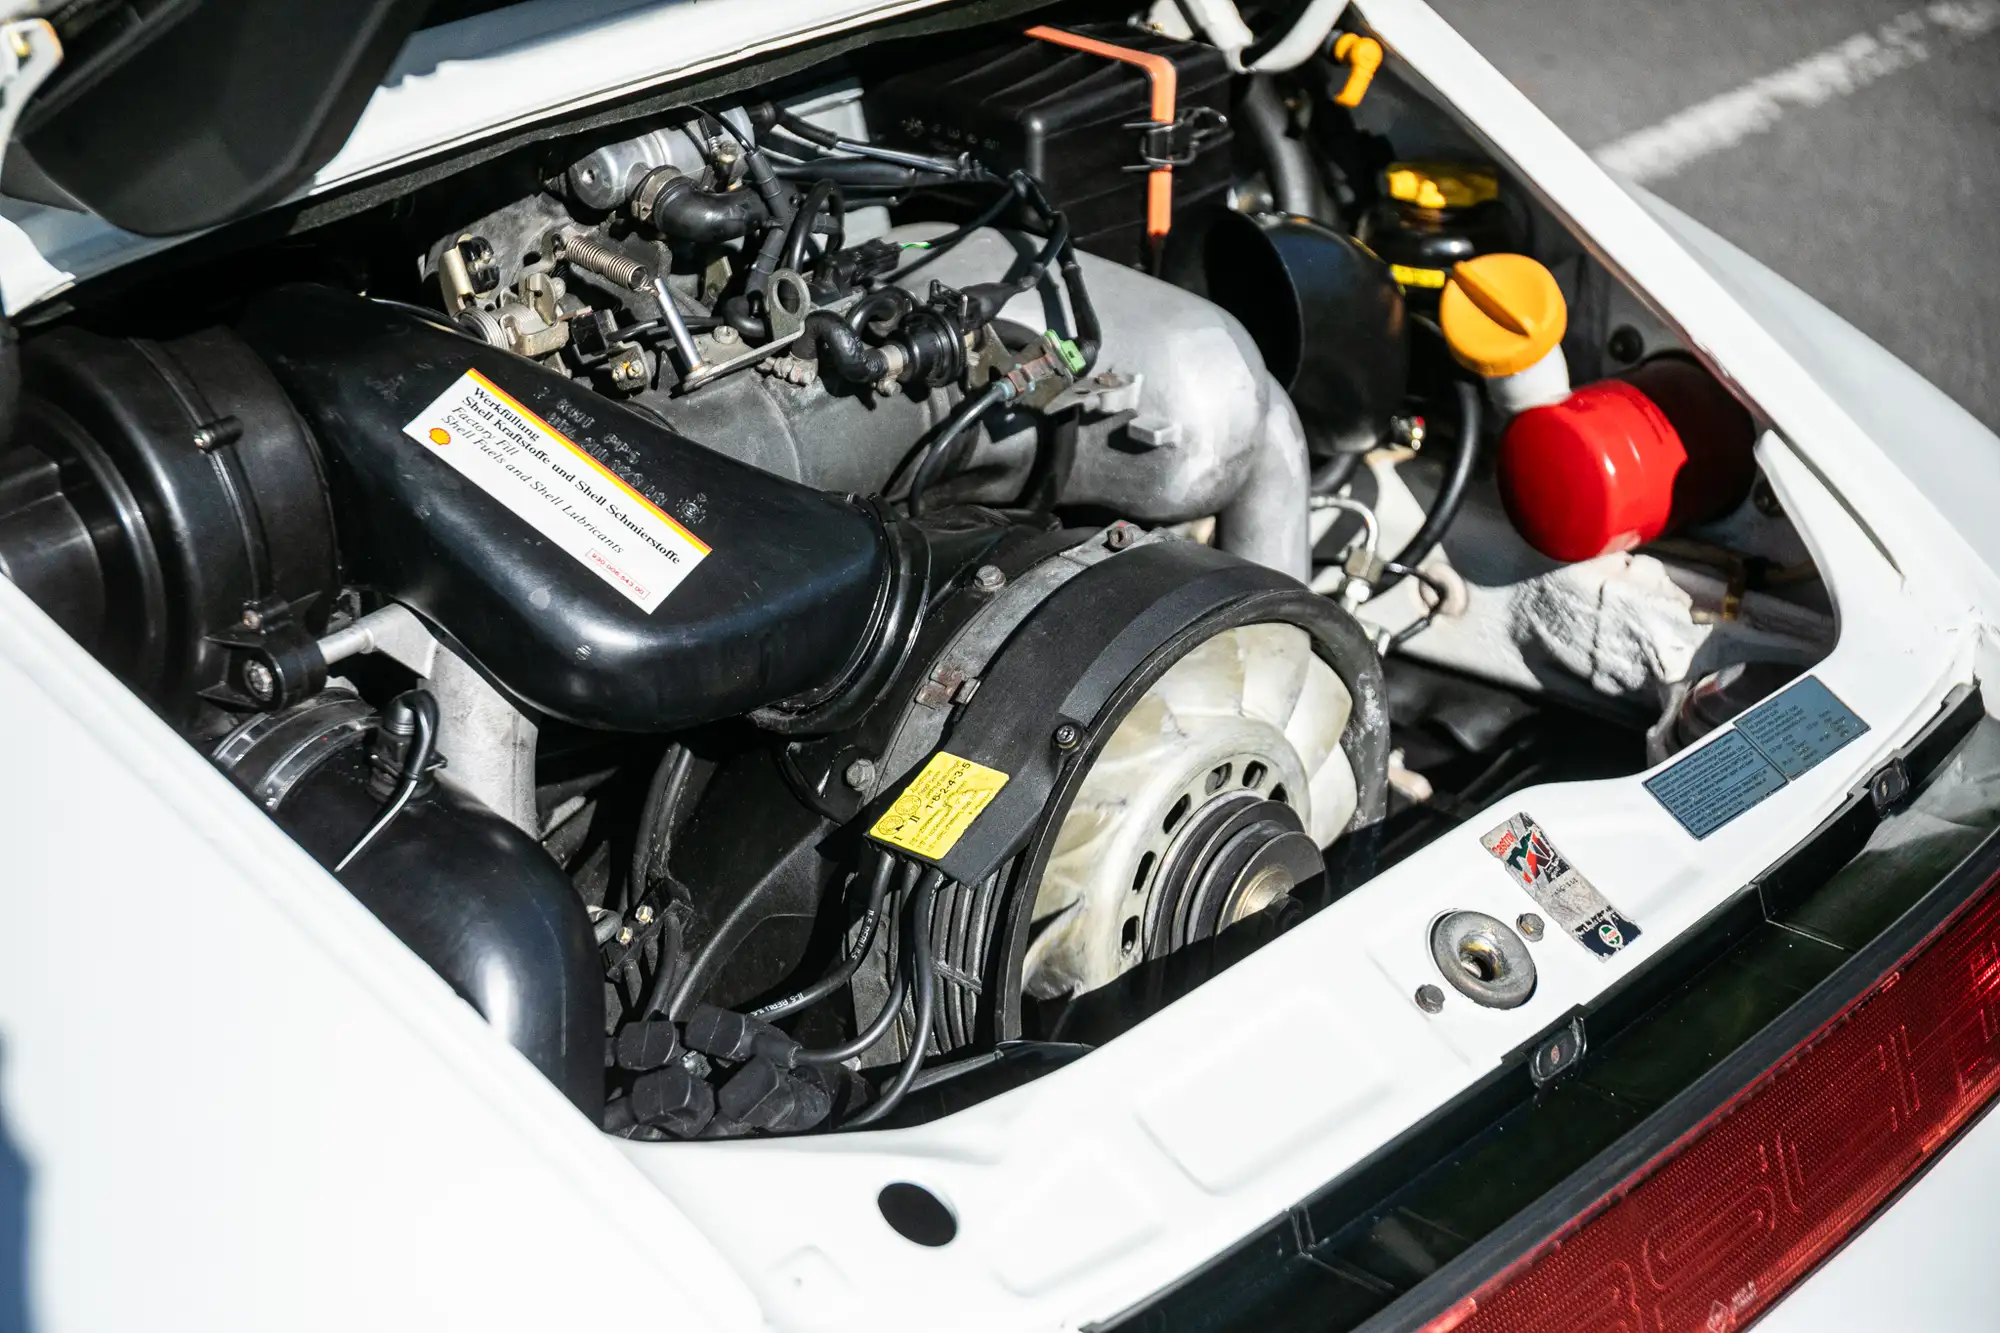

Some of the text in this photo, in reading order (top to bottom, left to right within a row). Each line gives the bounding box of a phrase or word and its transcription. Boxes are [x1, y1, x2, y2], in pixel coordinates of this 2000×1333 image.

[452, 407, 519, 455] Factory Fill
[475, 387, 539, 442] Werkfüllung
[442, 415, 624, 555] Shell Fuels and Shell Lubricants
[462, 396, 494, 421] Shell
[493, 419, 550, 463] Kraftstoffe
[552, 464, 576, 482] und
[575, 480, 607, 506] Shell
[606, 504, 680, 564] Schmierstoffe
